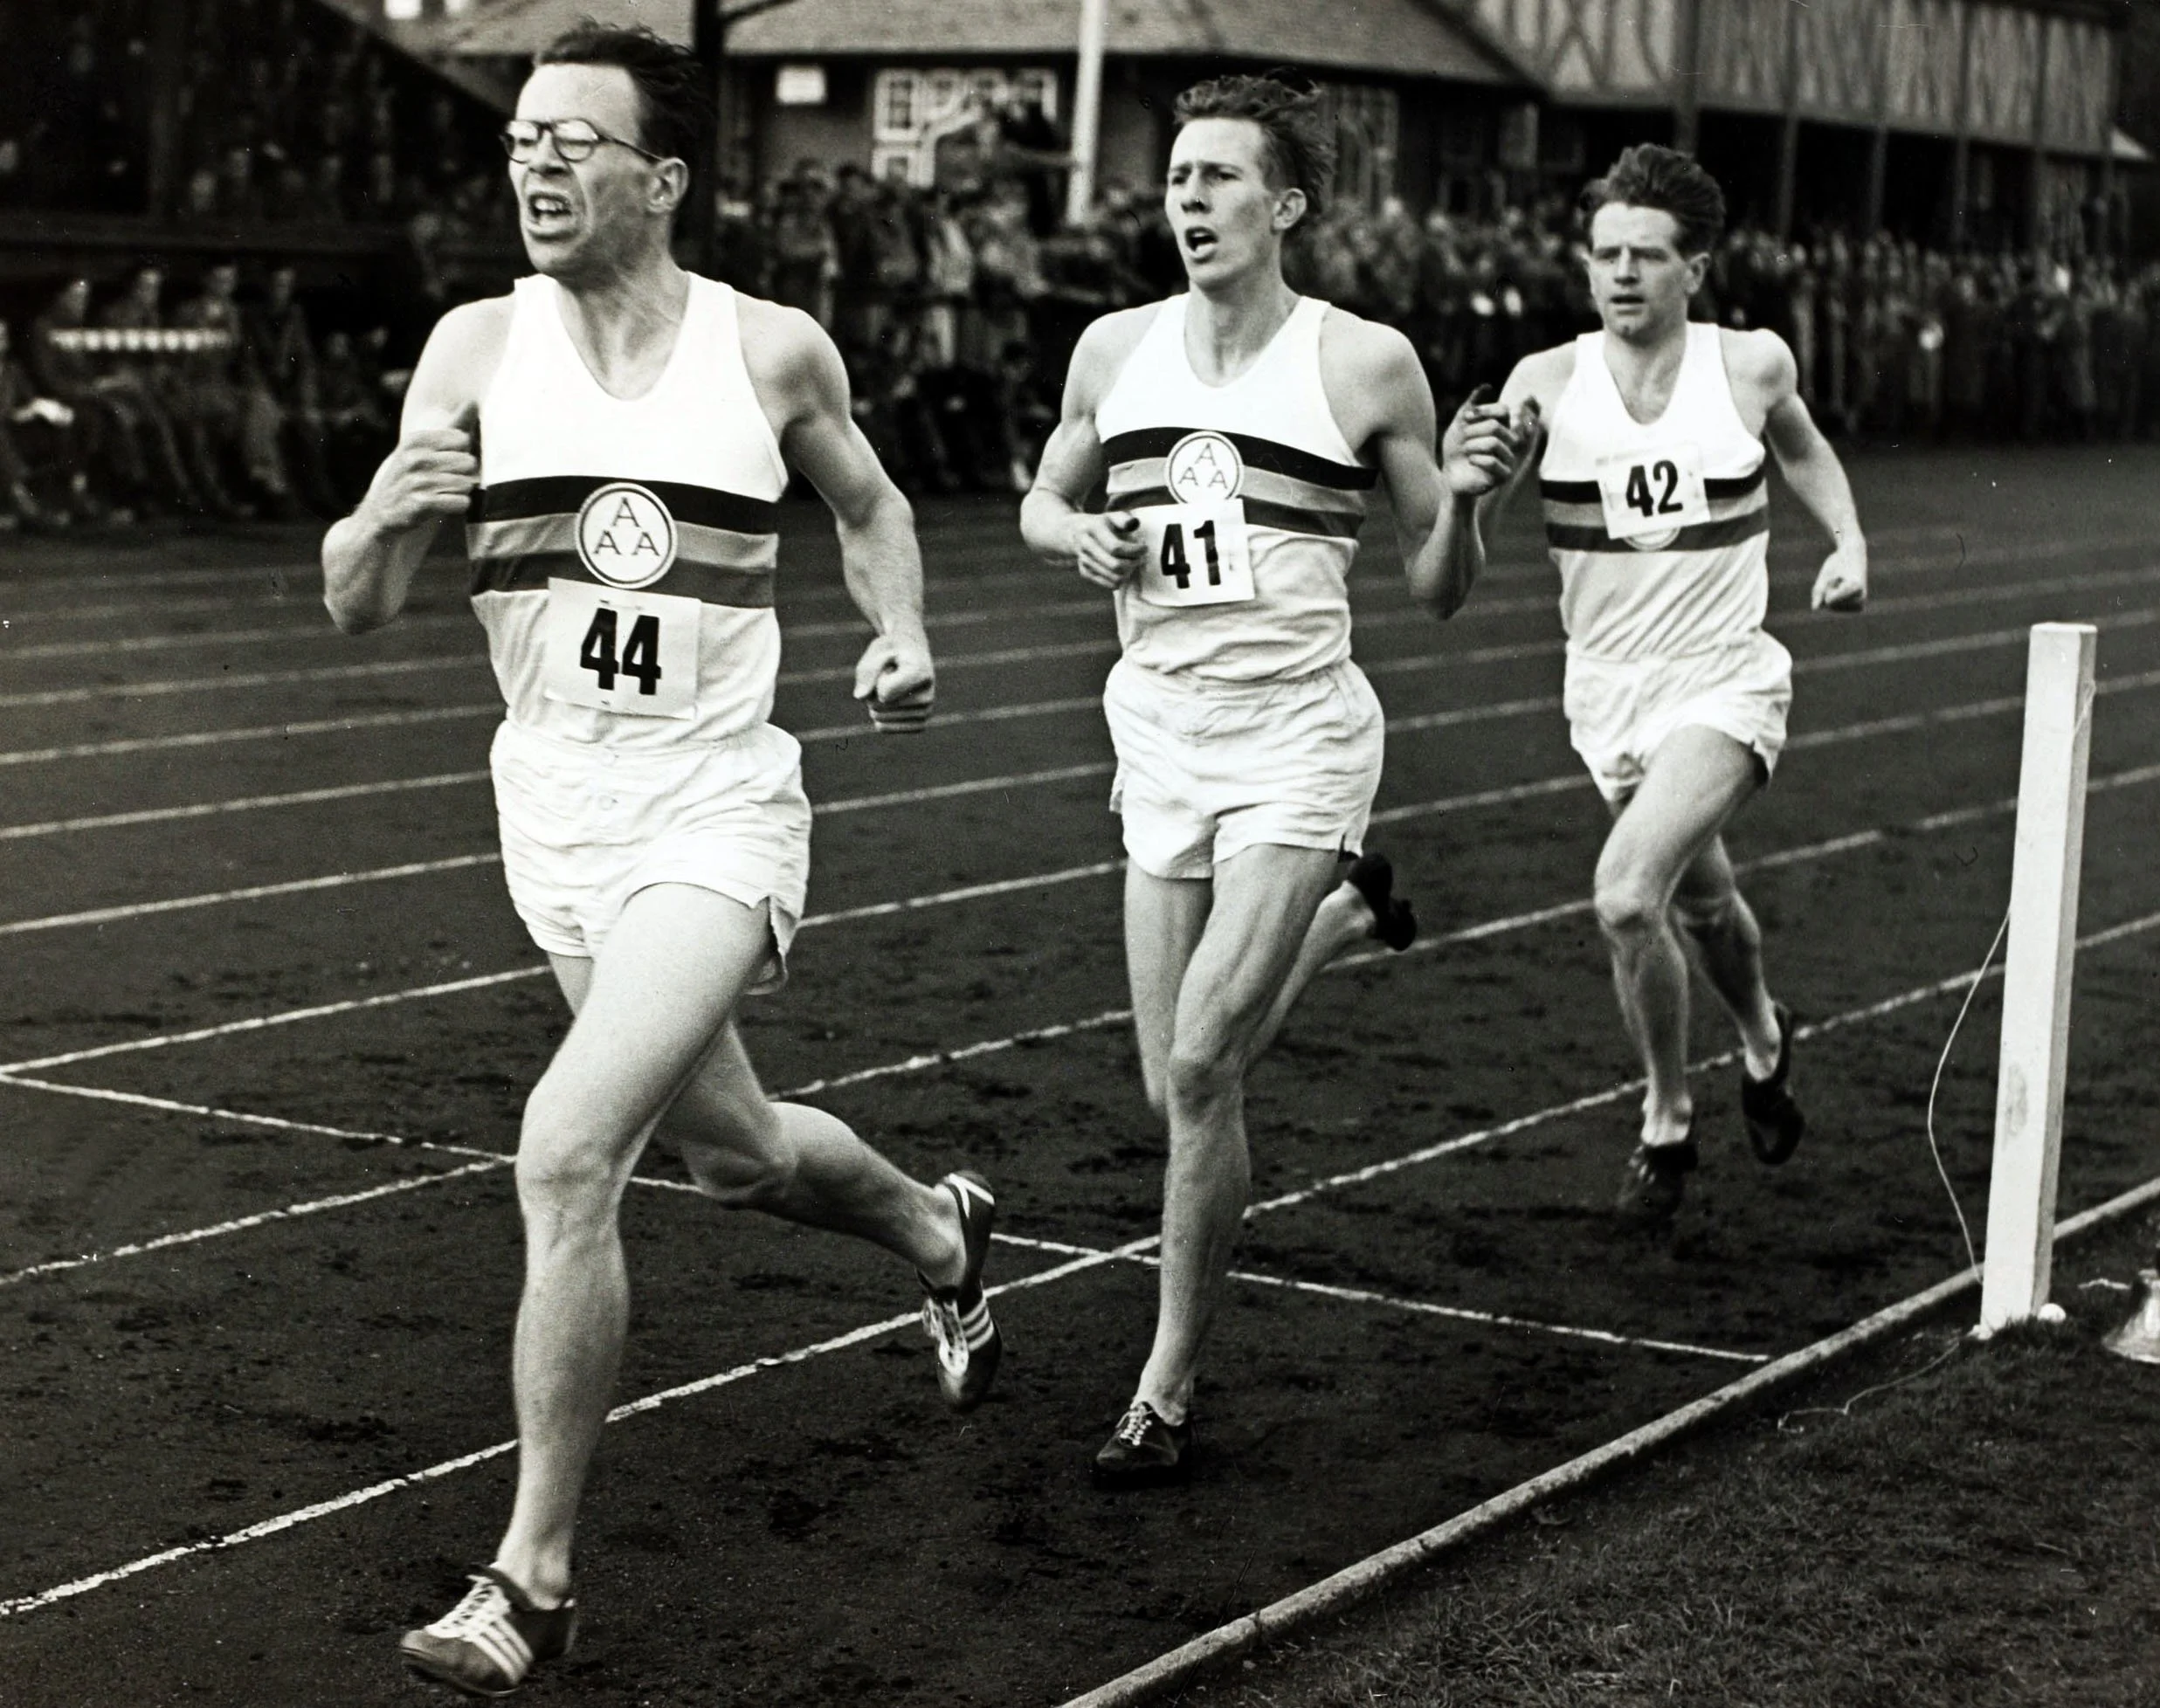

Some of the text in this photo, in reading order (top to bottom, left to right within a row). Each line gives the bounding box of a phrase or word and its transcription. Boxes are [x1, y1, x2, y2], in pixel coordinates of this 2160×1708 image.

[1195, 442, 1217, 466] A
[1178, 466, 1228, 489] A A
[1625, 459, 1683, 518] 42
[612, 497, 641, 528] A
[593, 530, 660, 556] A A
[1160, 520, 1221, 589] 41
[580, 607, 661, 696] 44
